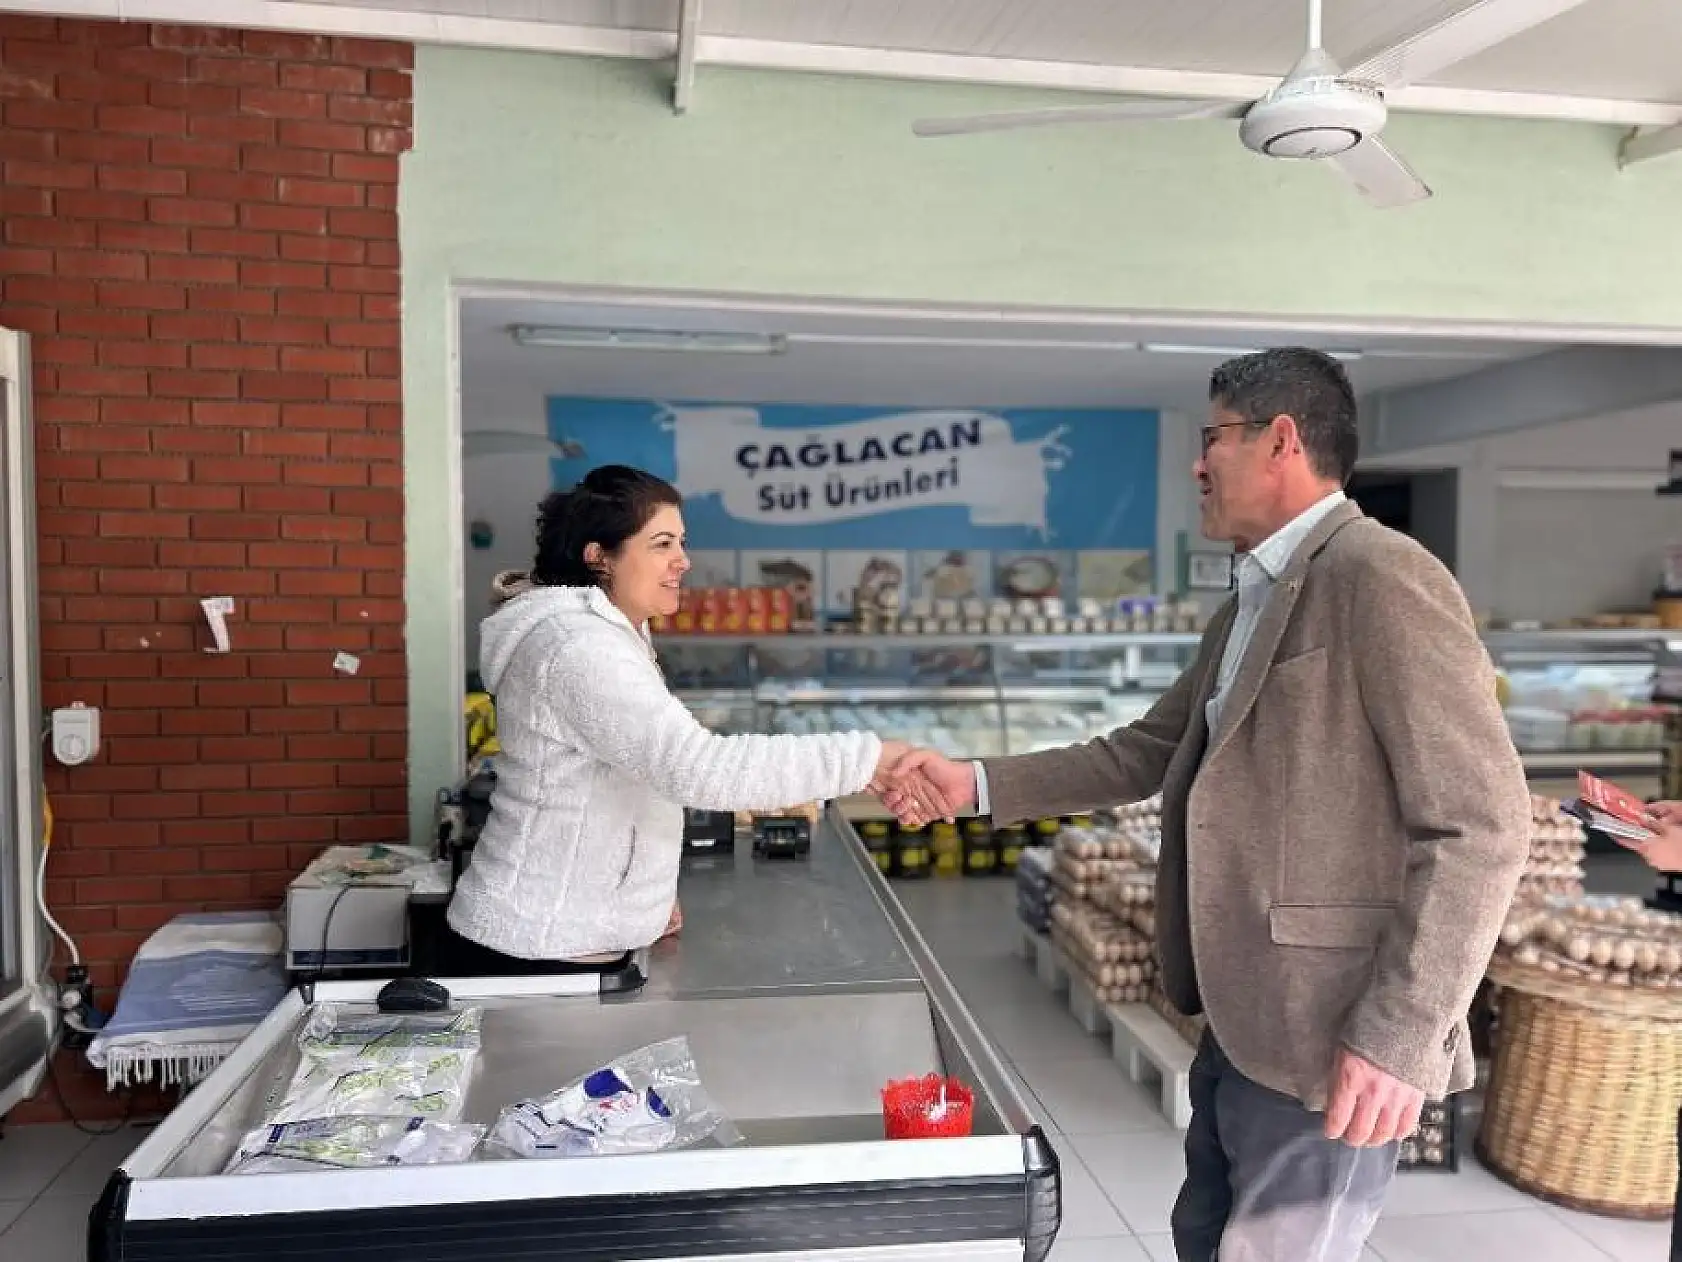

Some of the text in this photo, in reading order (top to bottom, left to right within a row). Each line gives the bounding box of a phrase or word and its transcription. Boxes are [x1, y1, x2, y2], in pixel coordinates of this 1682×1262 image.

[735, 418, 982, 479] ÇAĞLACAN
[758, 456, 959, 511] Süt Ürünleri
